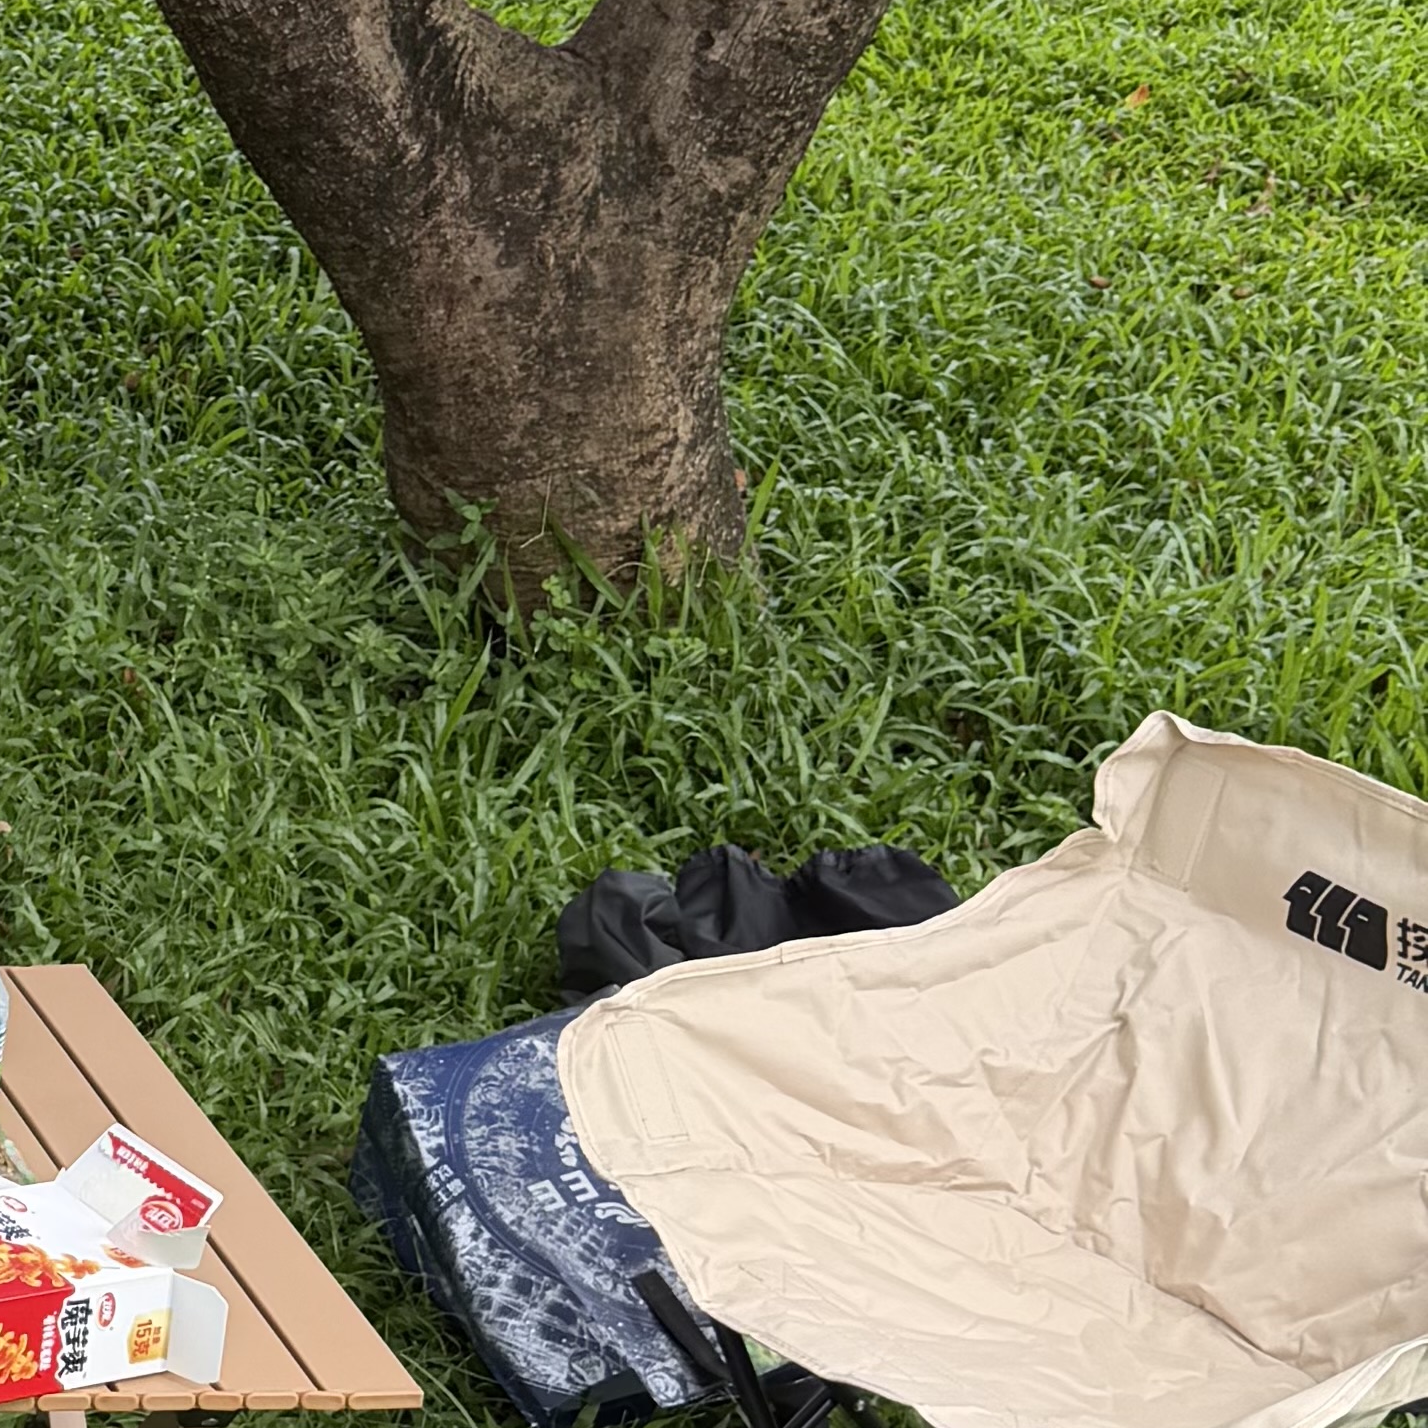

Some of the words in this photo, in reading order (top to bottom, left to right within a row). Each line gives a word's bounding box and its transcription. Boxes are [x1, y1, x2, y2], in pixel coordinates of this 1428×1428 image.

[58, 1297, 92, 1378] 魔芋爽
[132, 1319, 153, 1358] 15克
